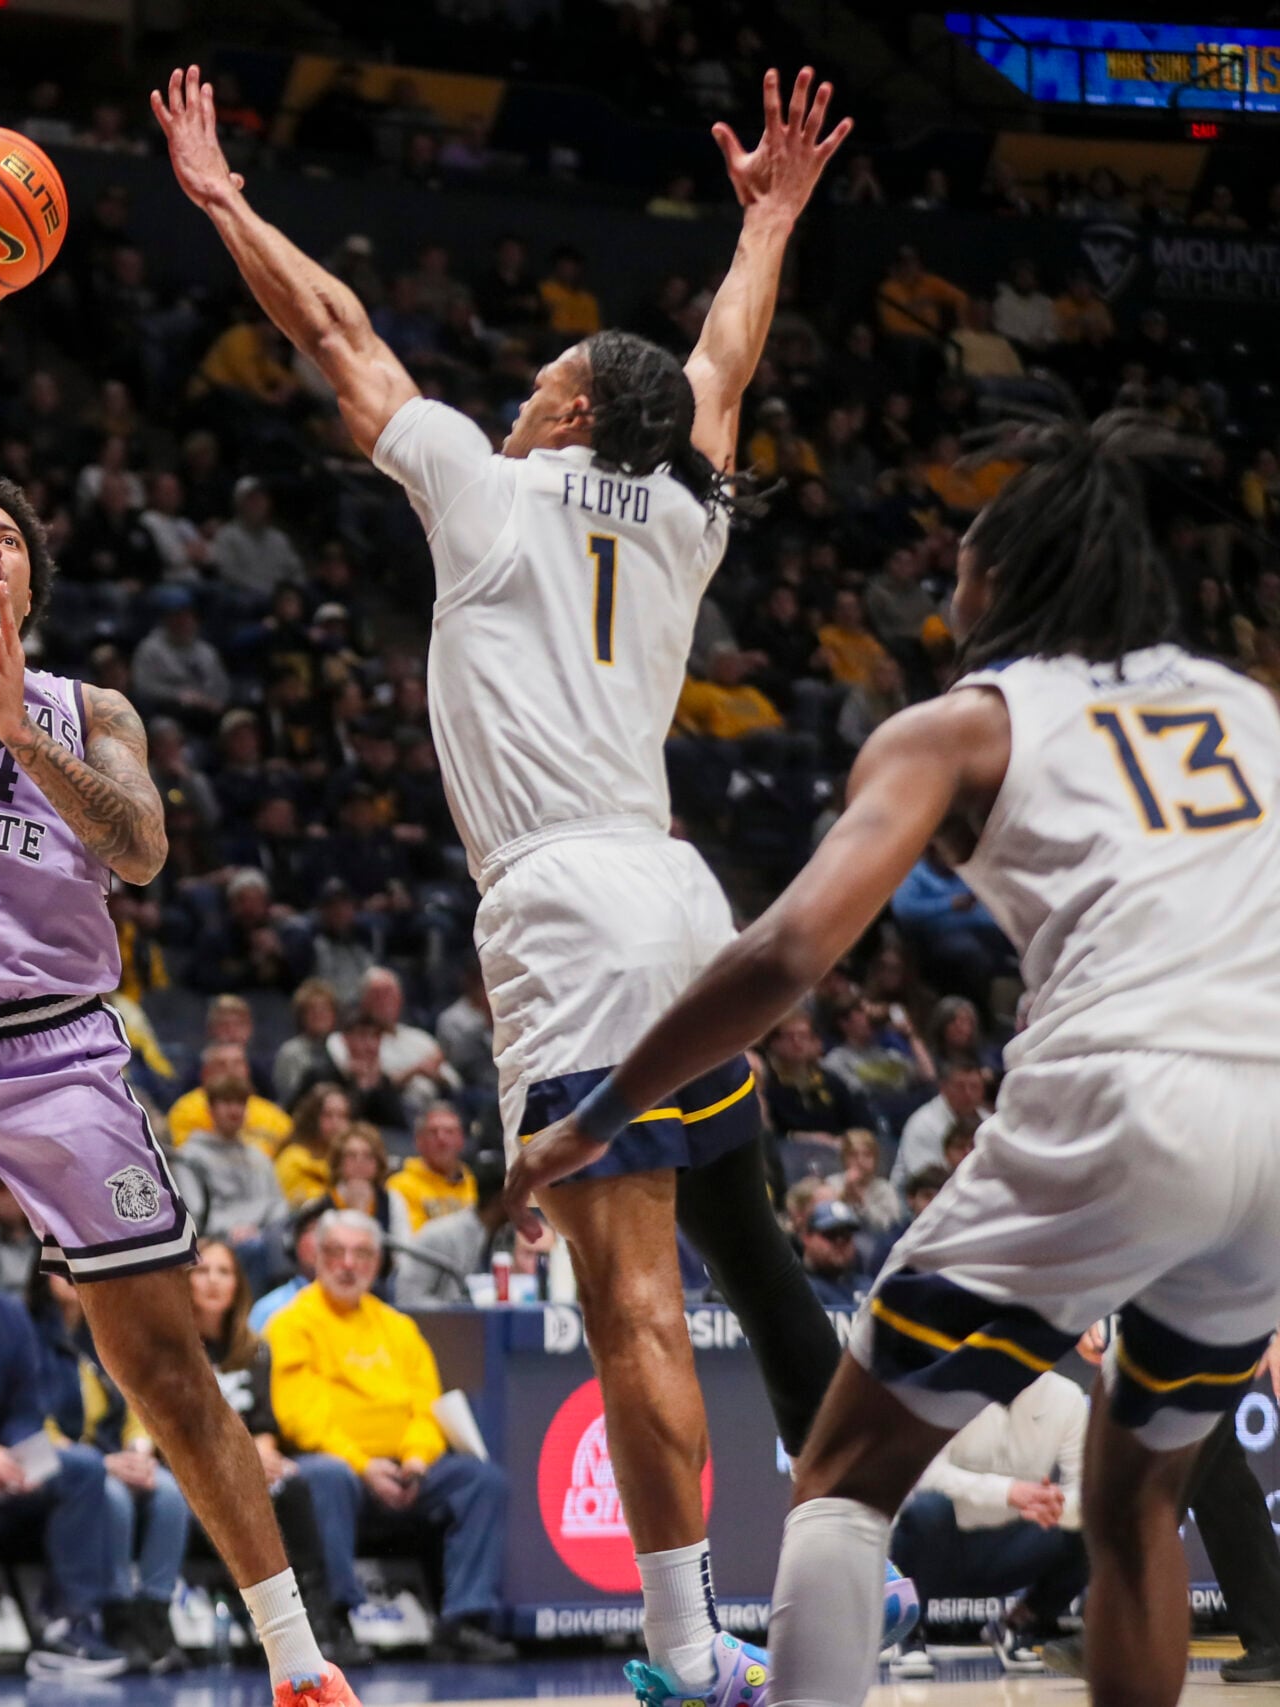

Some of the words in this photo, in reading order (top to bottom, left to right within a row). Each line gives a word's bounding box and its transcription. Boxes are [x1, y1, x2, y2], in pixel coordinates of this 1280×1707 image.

[0, 150, 60, 235] ELITE
[562, 473, 650, 524] FLOYD
[587, 532, 618, 667] 1
[1086, 703, 1265, 834] 13
[927, 1597, 1001, 1624] RSIFIED
